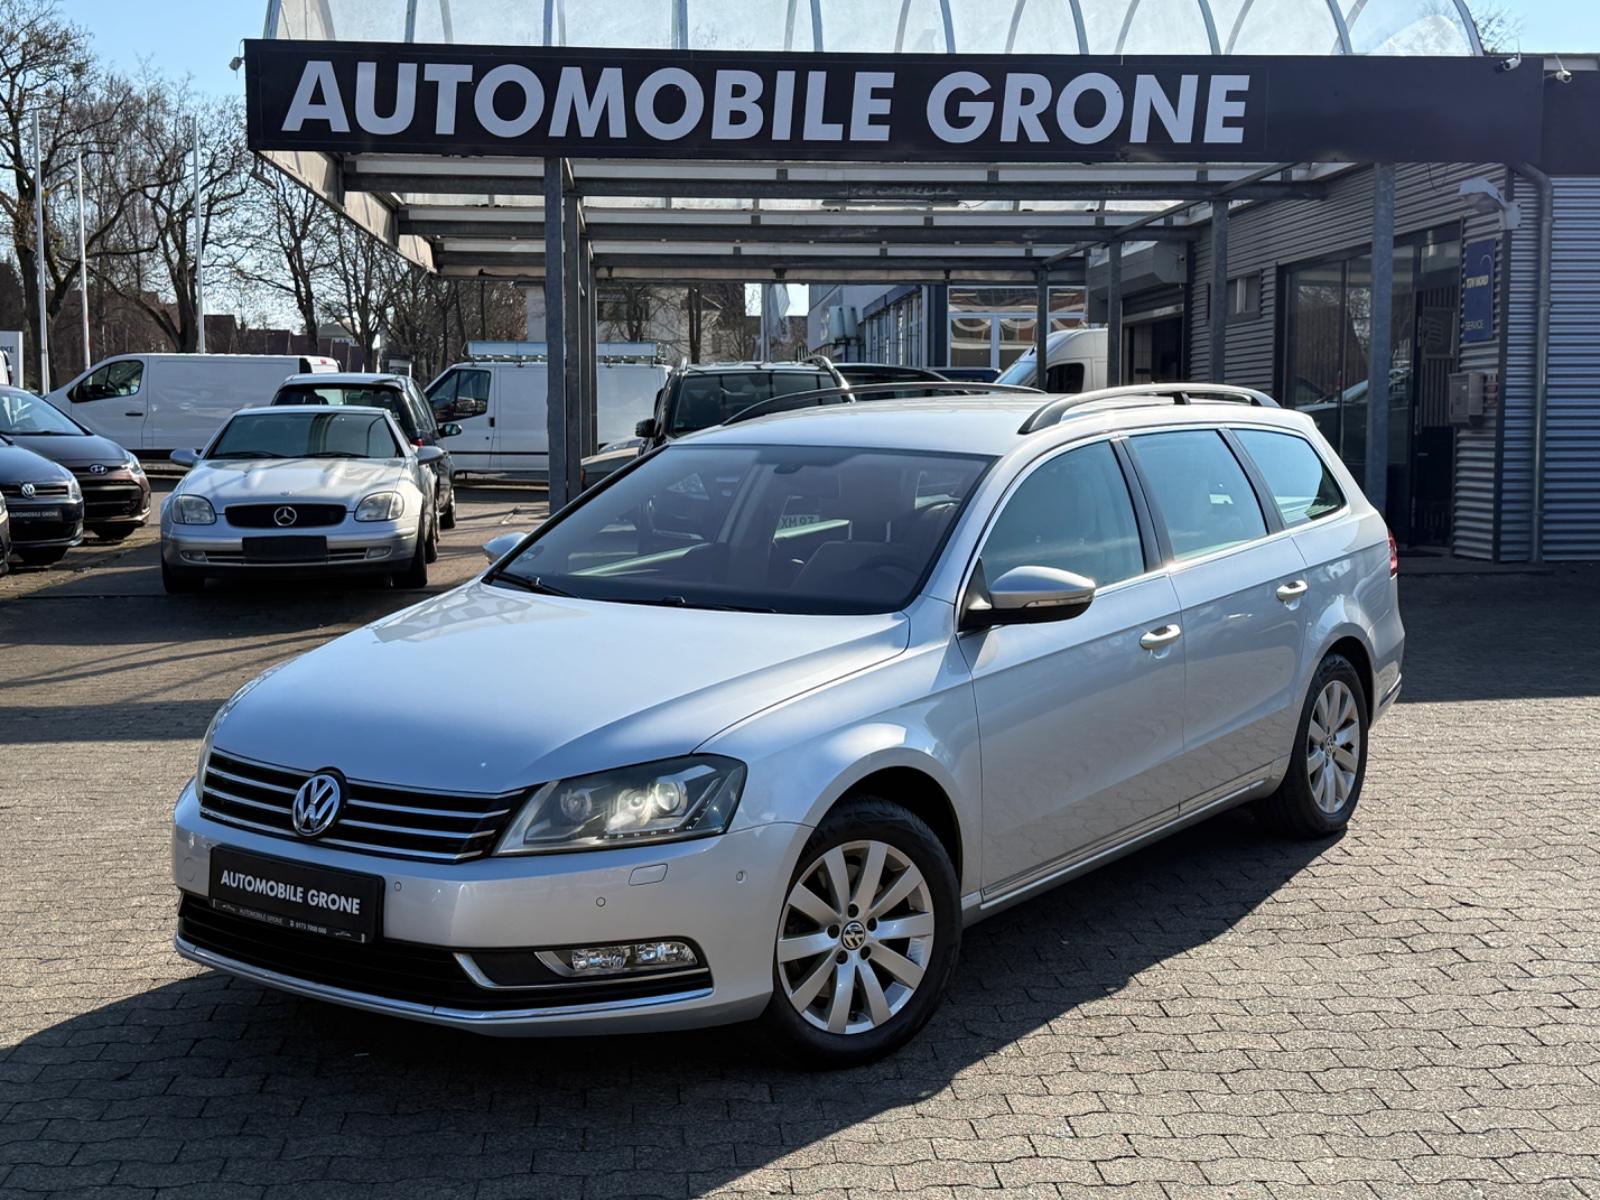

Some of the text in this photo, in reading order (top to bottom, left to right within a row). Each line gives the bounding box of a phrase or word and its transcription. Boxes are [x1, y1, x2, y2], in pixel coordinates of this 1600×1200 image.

[281, 59, 1251, 145] AUTOMOBILE GRONE
[220, 869, 361, 915] AUTOMOBILE GRONE
